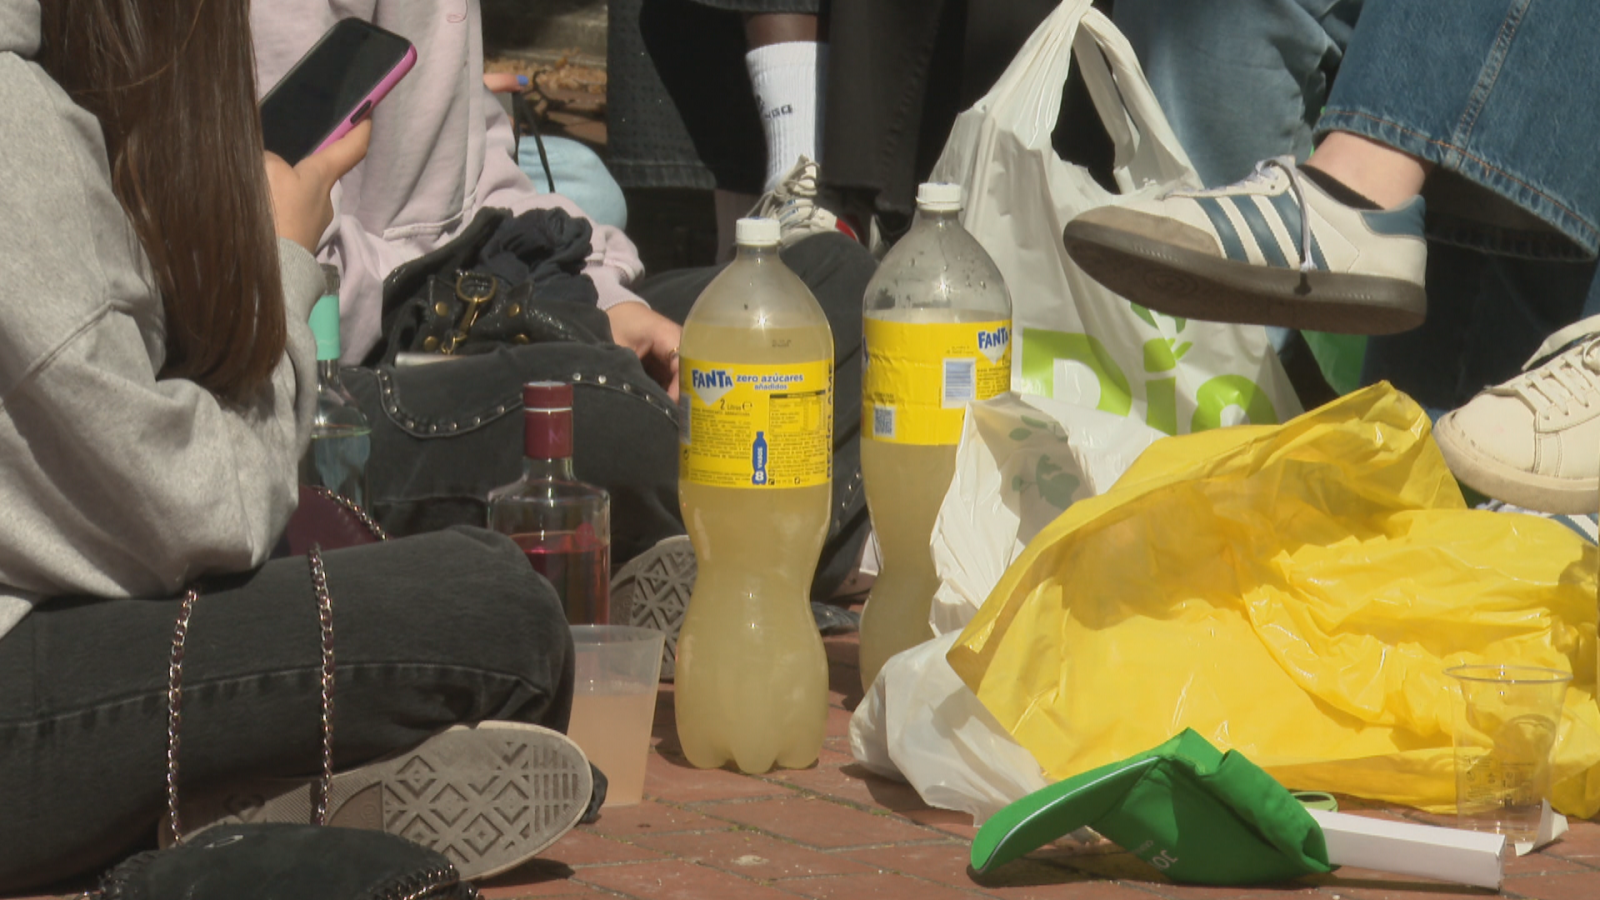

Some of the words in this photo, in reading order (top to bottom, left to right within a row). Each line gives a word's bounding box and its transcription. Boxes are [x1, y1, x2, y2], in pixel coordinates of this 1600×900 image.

[691, 369, 733, 389] FANTA
[736, 375, 758, 383] zero
[761, 372, 804, 383] azúcares
[754, 383, 788, 391] añadidos
[720, 398, 726, 411] 2
[755, 470, 764, 482] 8
